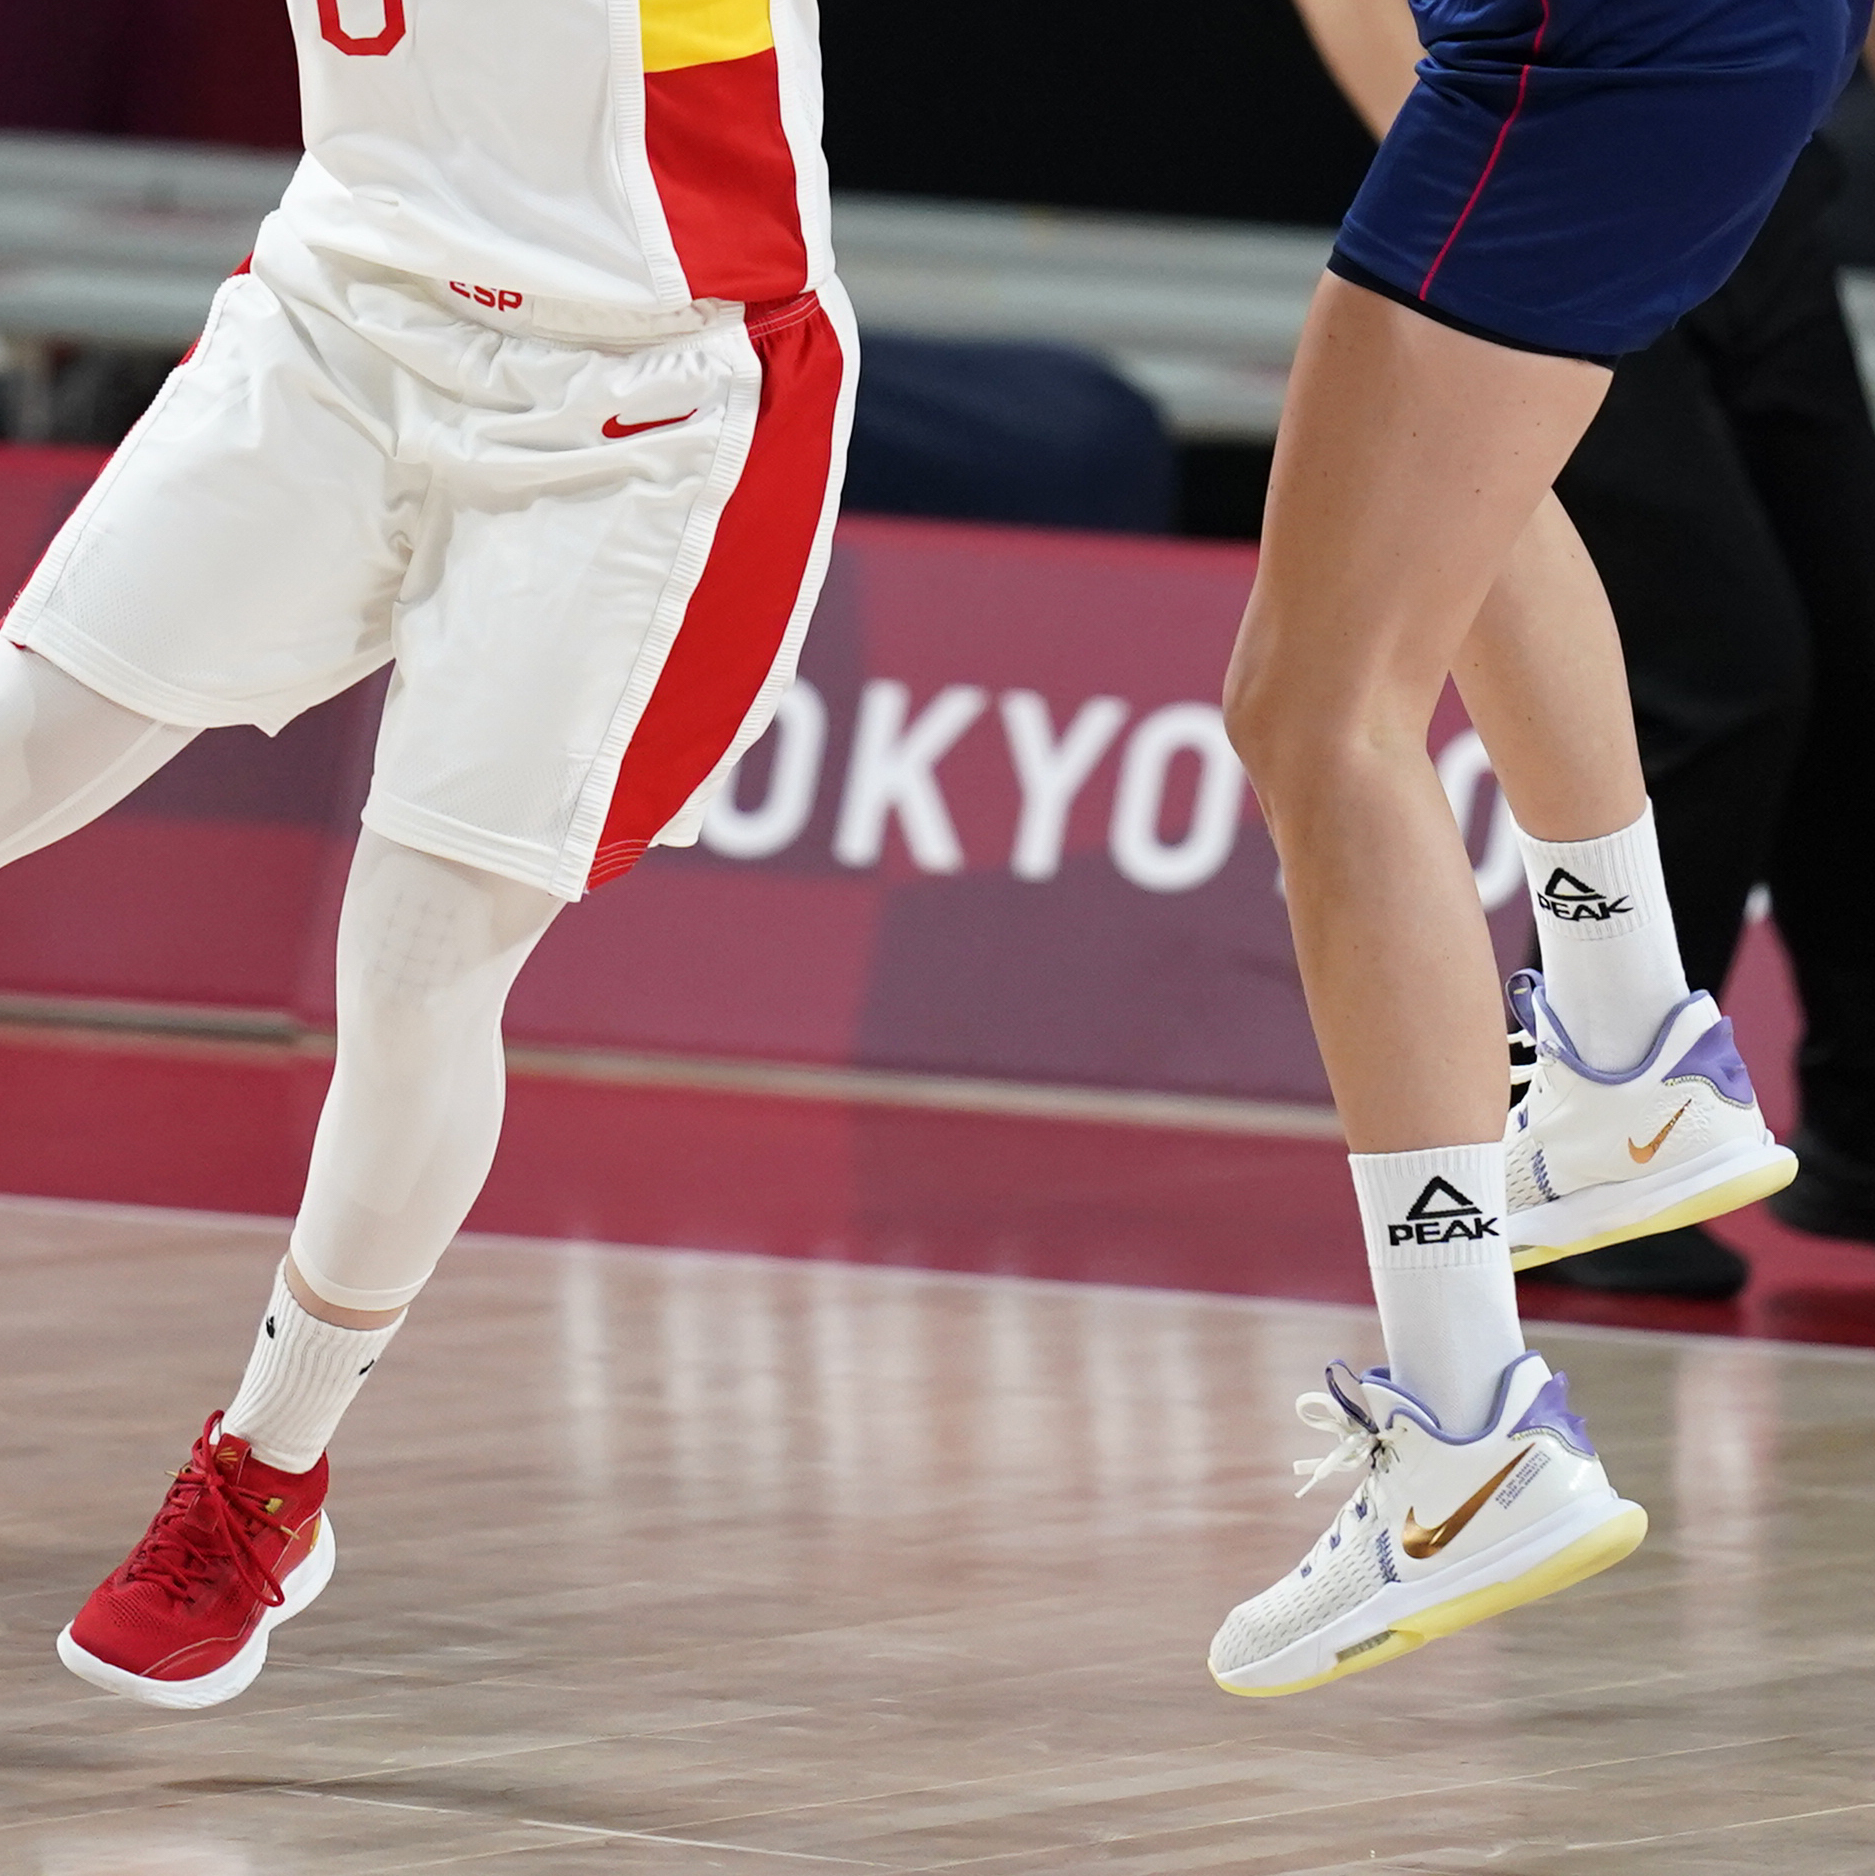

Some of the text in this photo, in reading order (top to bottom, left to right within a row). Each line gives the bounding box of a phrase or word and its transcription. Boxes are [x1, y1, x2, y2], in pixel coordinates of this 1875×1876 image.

[449, 280, 523, 312] ESP
[700, 676, 1248, 892] OKYO
[1536, 891, 1634, 921] PEAK
[1388, 1217, 1500, 1246] PEAK
